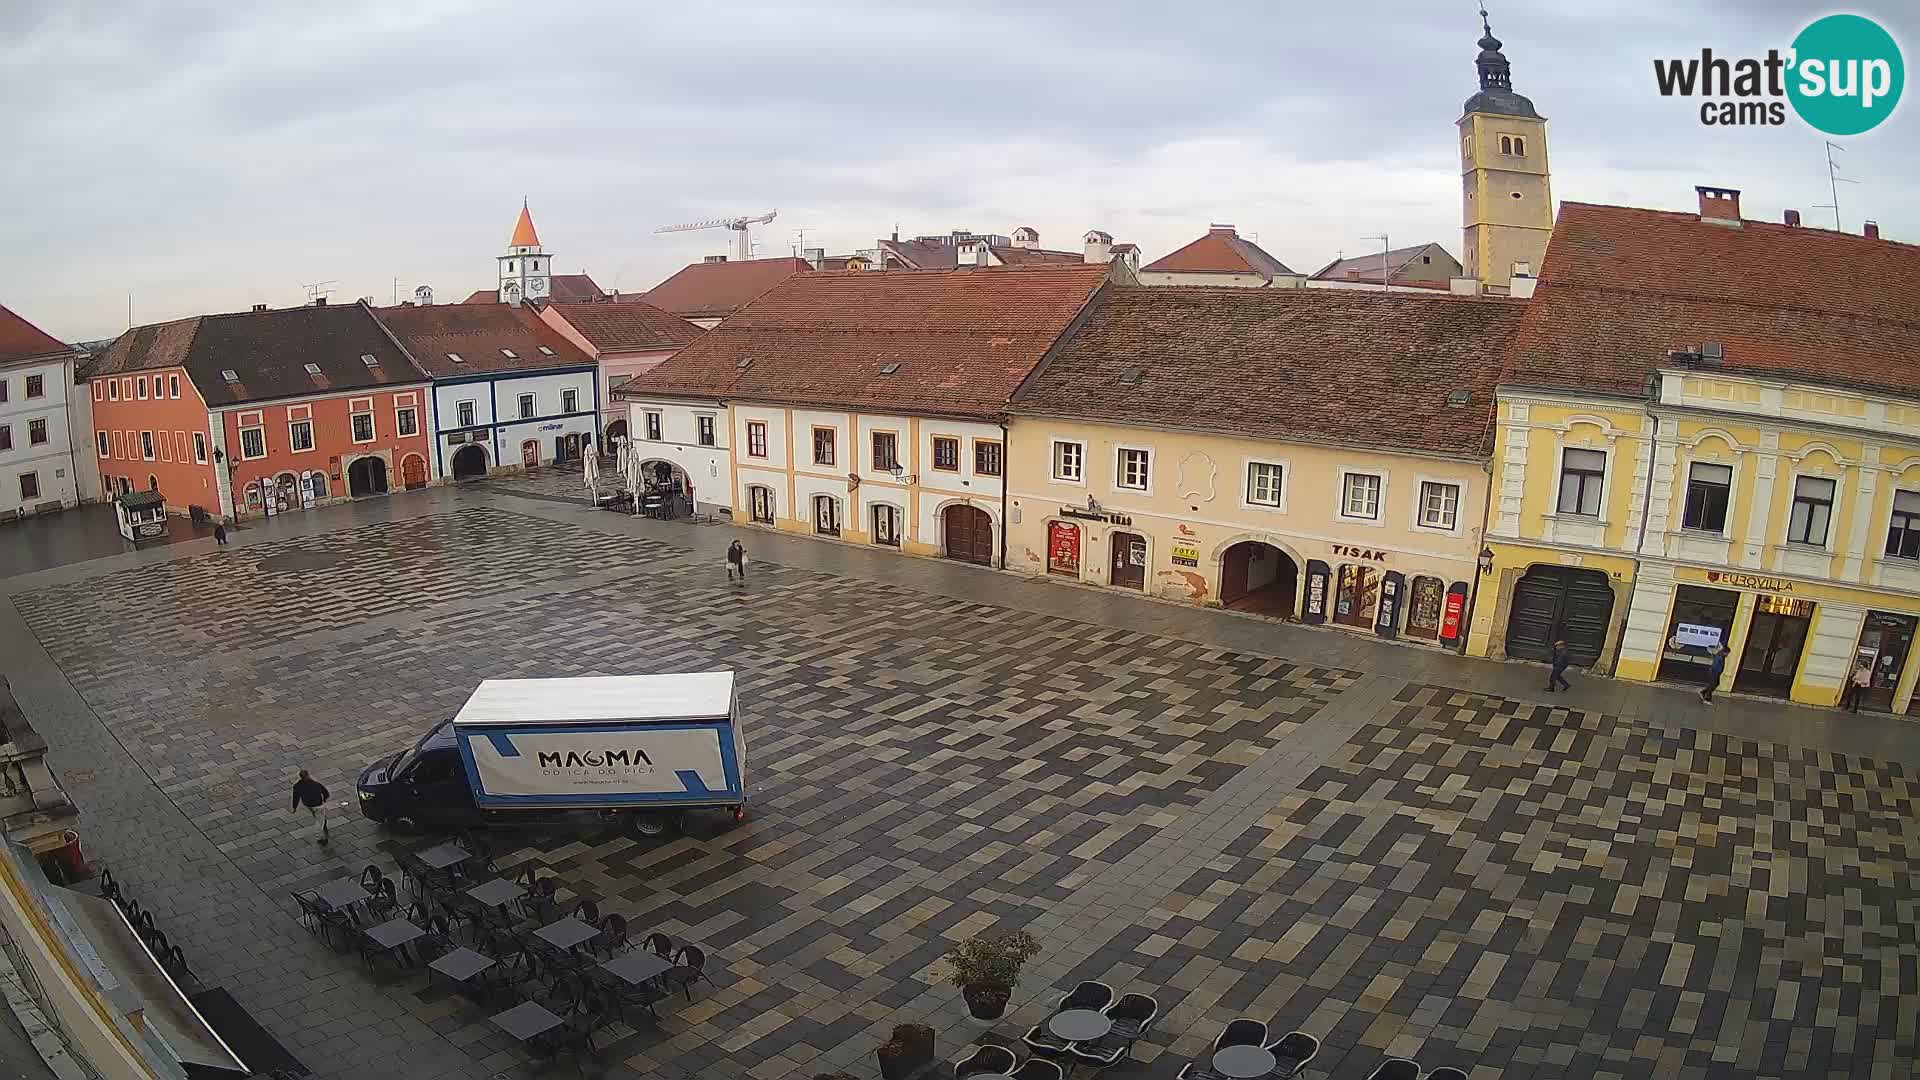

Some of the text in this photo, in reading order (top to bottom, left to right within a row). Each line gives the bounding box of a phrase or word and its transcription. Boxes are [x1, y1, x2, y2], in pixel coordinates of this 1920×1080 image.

[1173, 547, 1196, 556] FOTO
[1332, 544, 1388, 561] TISAK
[1722, 572, 1794, 591] EUROVILLA
[538, 749, 653, 768] MAGMA
